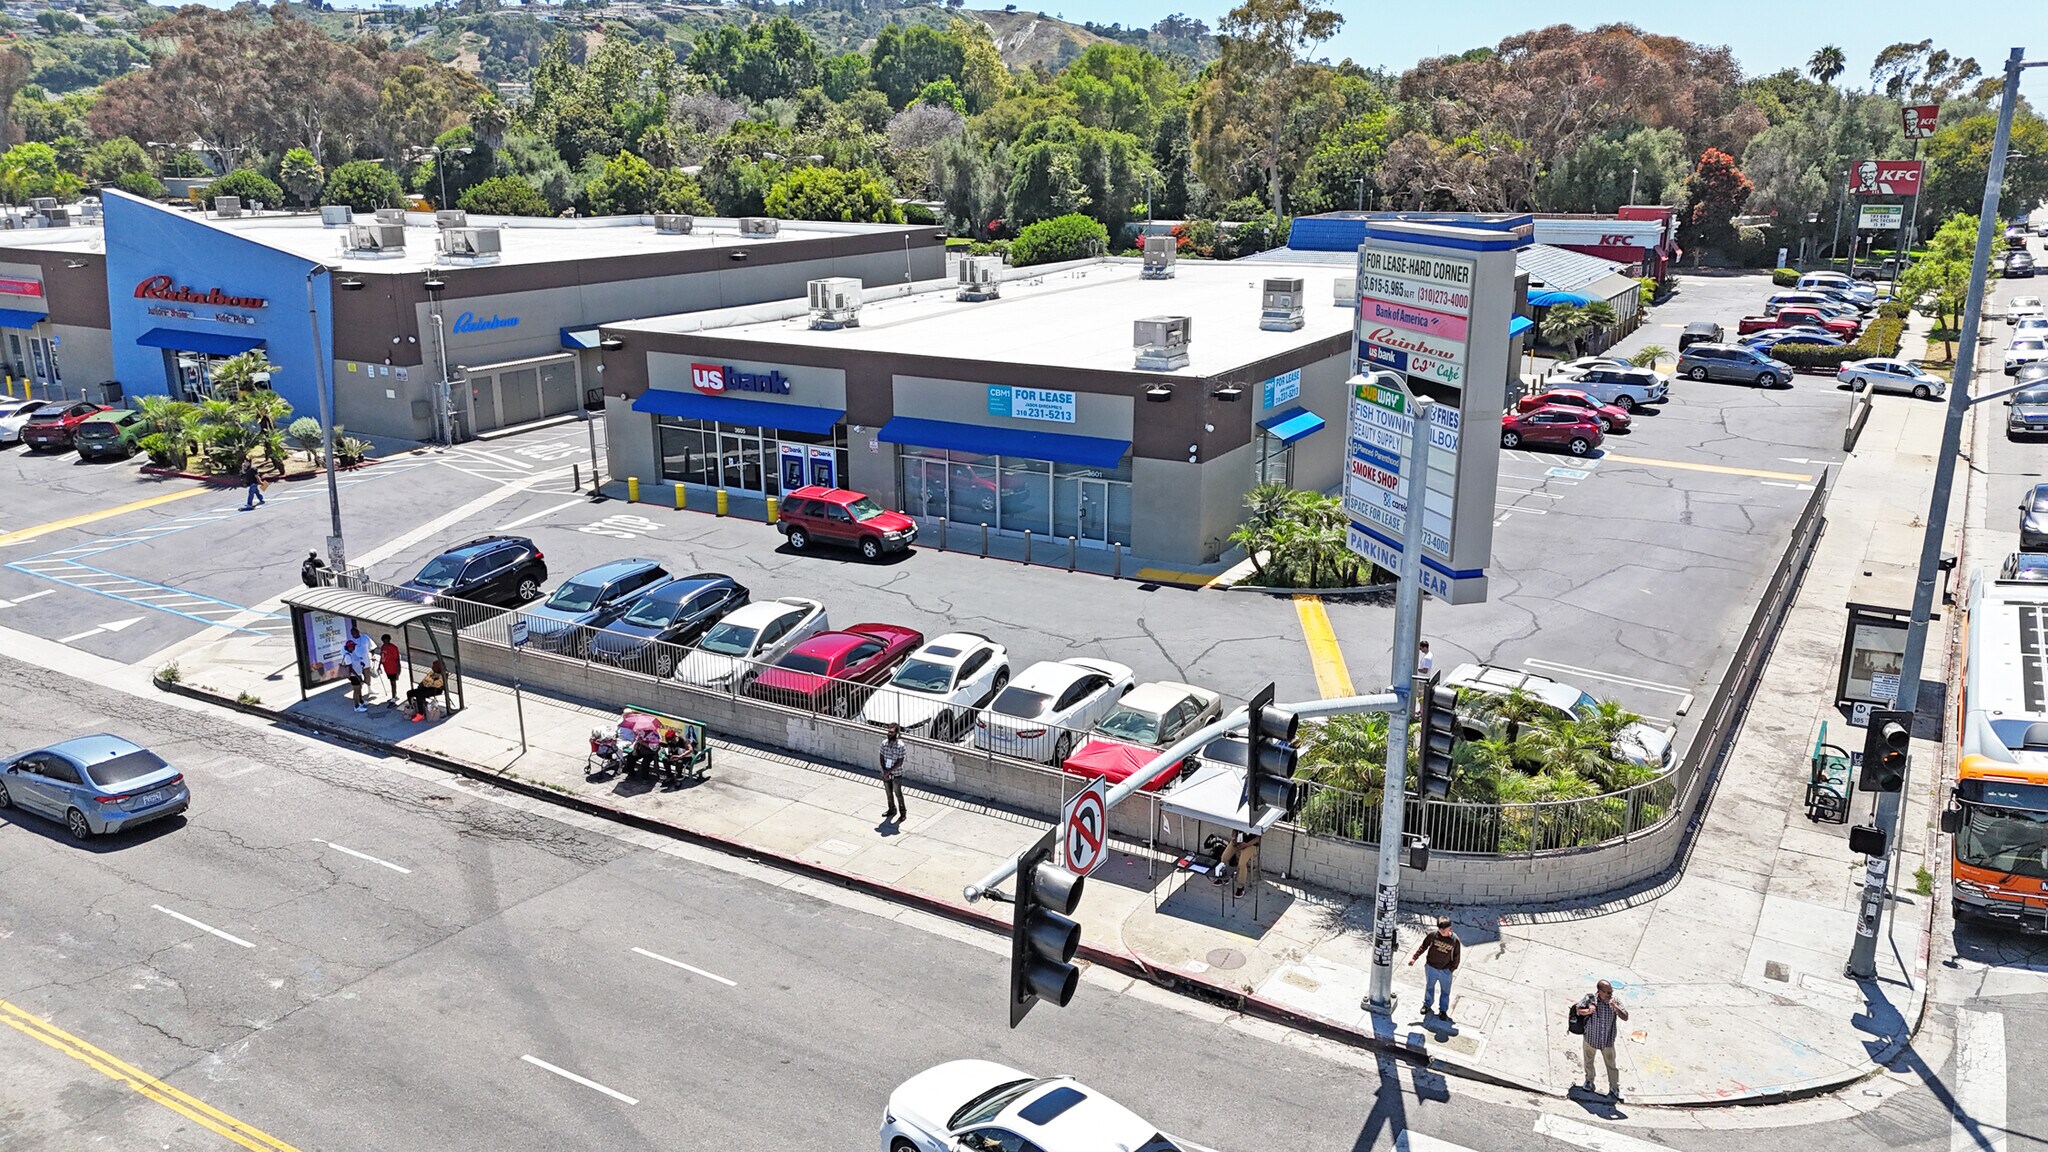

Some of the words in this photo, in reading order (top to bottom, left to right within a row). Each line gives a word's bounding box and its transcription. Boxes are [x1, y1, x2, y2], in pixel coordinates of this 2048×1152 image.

[1879, 170, 1919, 181] KFC
[1599, 234, 1635, 246] KFC
[1366, 252, 1382, 269] FOR
[1382, 256, 1432, 278] LEASE-HARD
[1433, 262, 1469, 284] CORNER
[133, 275, 265, 309] Rainbow
[1363, 275, 1404, 297] 3,615-5,965
[1417, 287, 1469, 309] (310)273-4000
[452, 310, 521, 335] Rainbow
[1375, 304, 1392, 319] Bank
[1392, 307, 1400, 321] of
[1400, 309, 1428, 327] America
[1368, 327, 1455, 360] Rainbow
[1436, 364, 1460, 382] Café
[989, 388, 1011, 398] CBM1
[1015, 389, 1036, 401] FOR
[1039, 391, 1073, 404] LEASE
[1361, 385, 1400, 408] SUBWAY
[1028, 408, 1072, 421] 231-5213
[1355, 402, 1374, 421] FISH
[1376, 409, 1402, 431] TOWN
[1354, 422, 1376, 441] BEAUTY
[1376, 430, 1401, 451] SUPPLY
[1429, 428, 1459, 450] ILBOX
[1352, 460, 1376, 482] SMOKE
[1377, 470, 1398, 490] SHOP
[578, 514, 666, 539] STOP
[1350, 497, 1369, 516] SPACE
[1369, 506, 1381, 520] FOR
[1382, 512, 1400, 531] LEASE
[1350, 532, 1397, 569] PARKING
